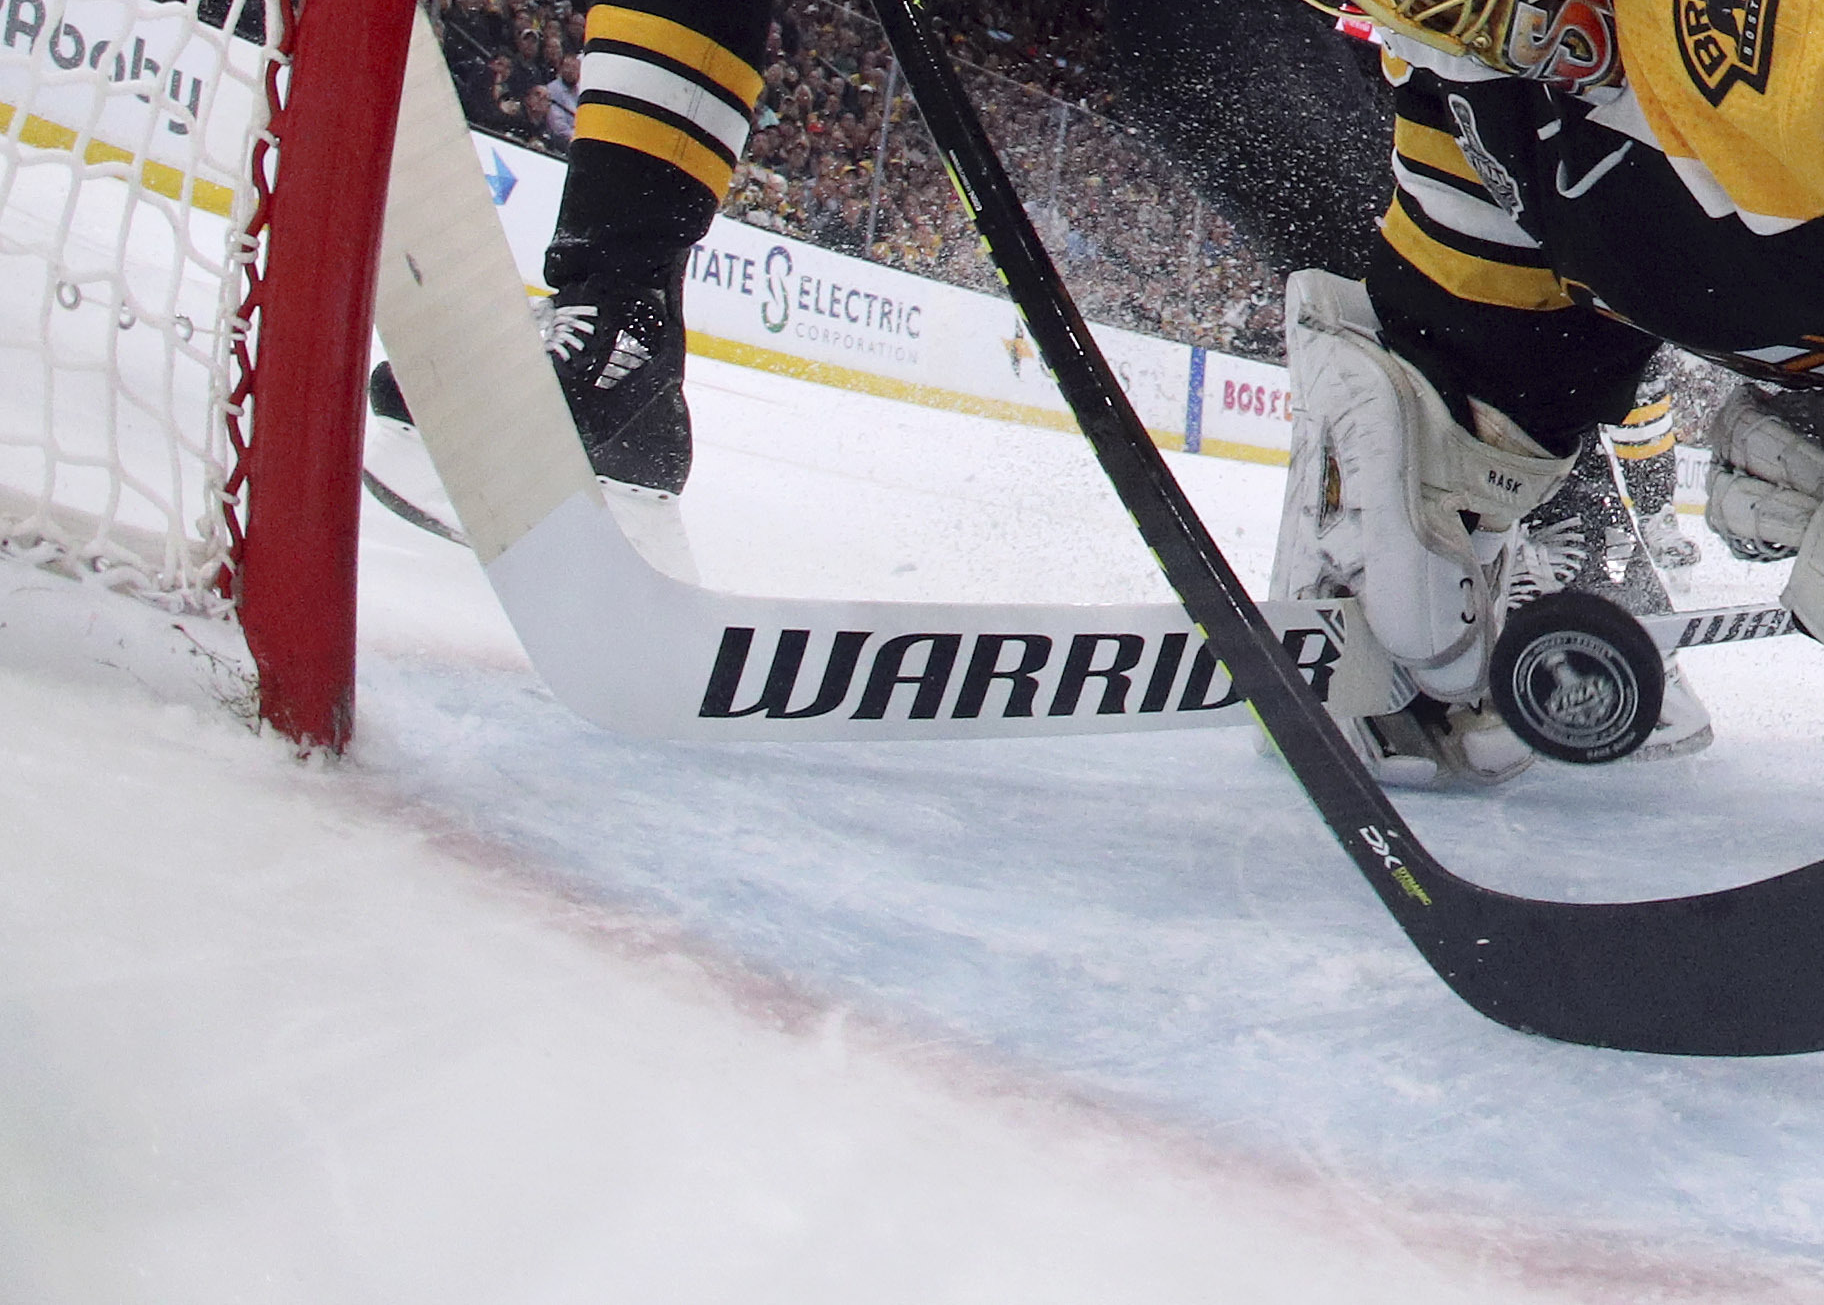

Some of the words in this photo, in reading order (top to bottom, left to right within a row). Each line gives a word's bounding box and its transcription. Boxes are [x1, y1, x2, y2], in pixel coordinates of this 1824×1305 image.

[797, 275, 922, 342] ELECTRIC
[796, 321, 919, 366] CORPORATION
[1488, 469, 1523, 495] RASK
